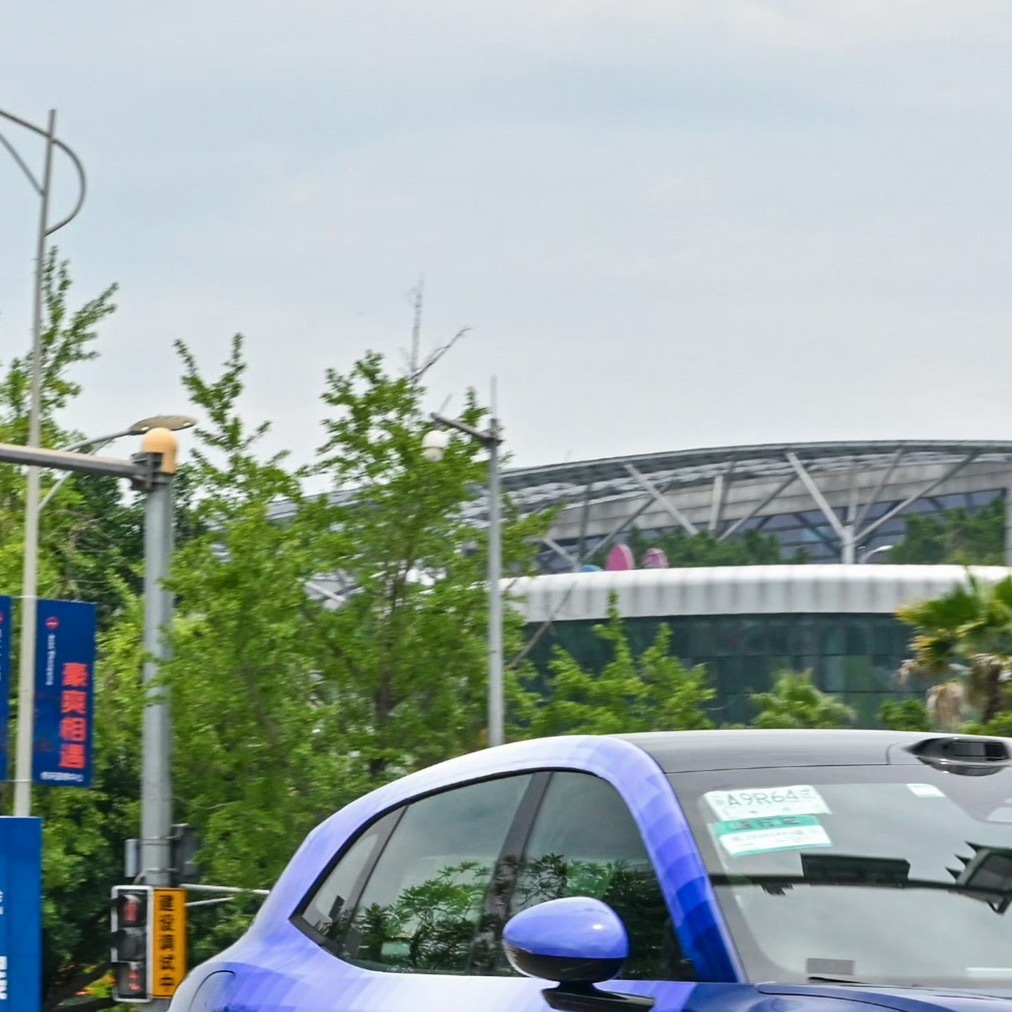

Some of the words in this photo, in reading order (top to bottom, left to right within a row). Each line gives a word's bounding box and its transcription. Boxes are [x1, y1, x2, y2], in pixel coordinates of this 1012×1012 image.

[158, 895, 175, 993] 建设调试中
